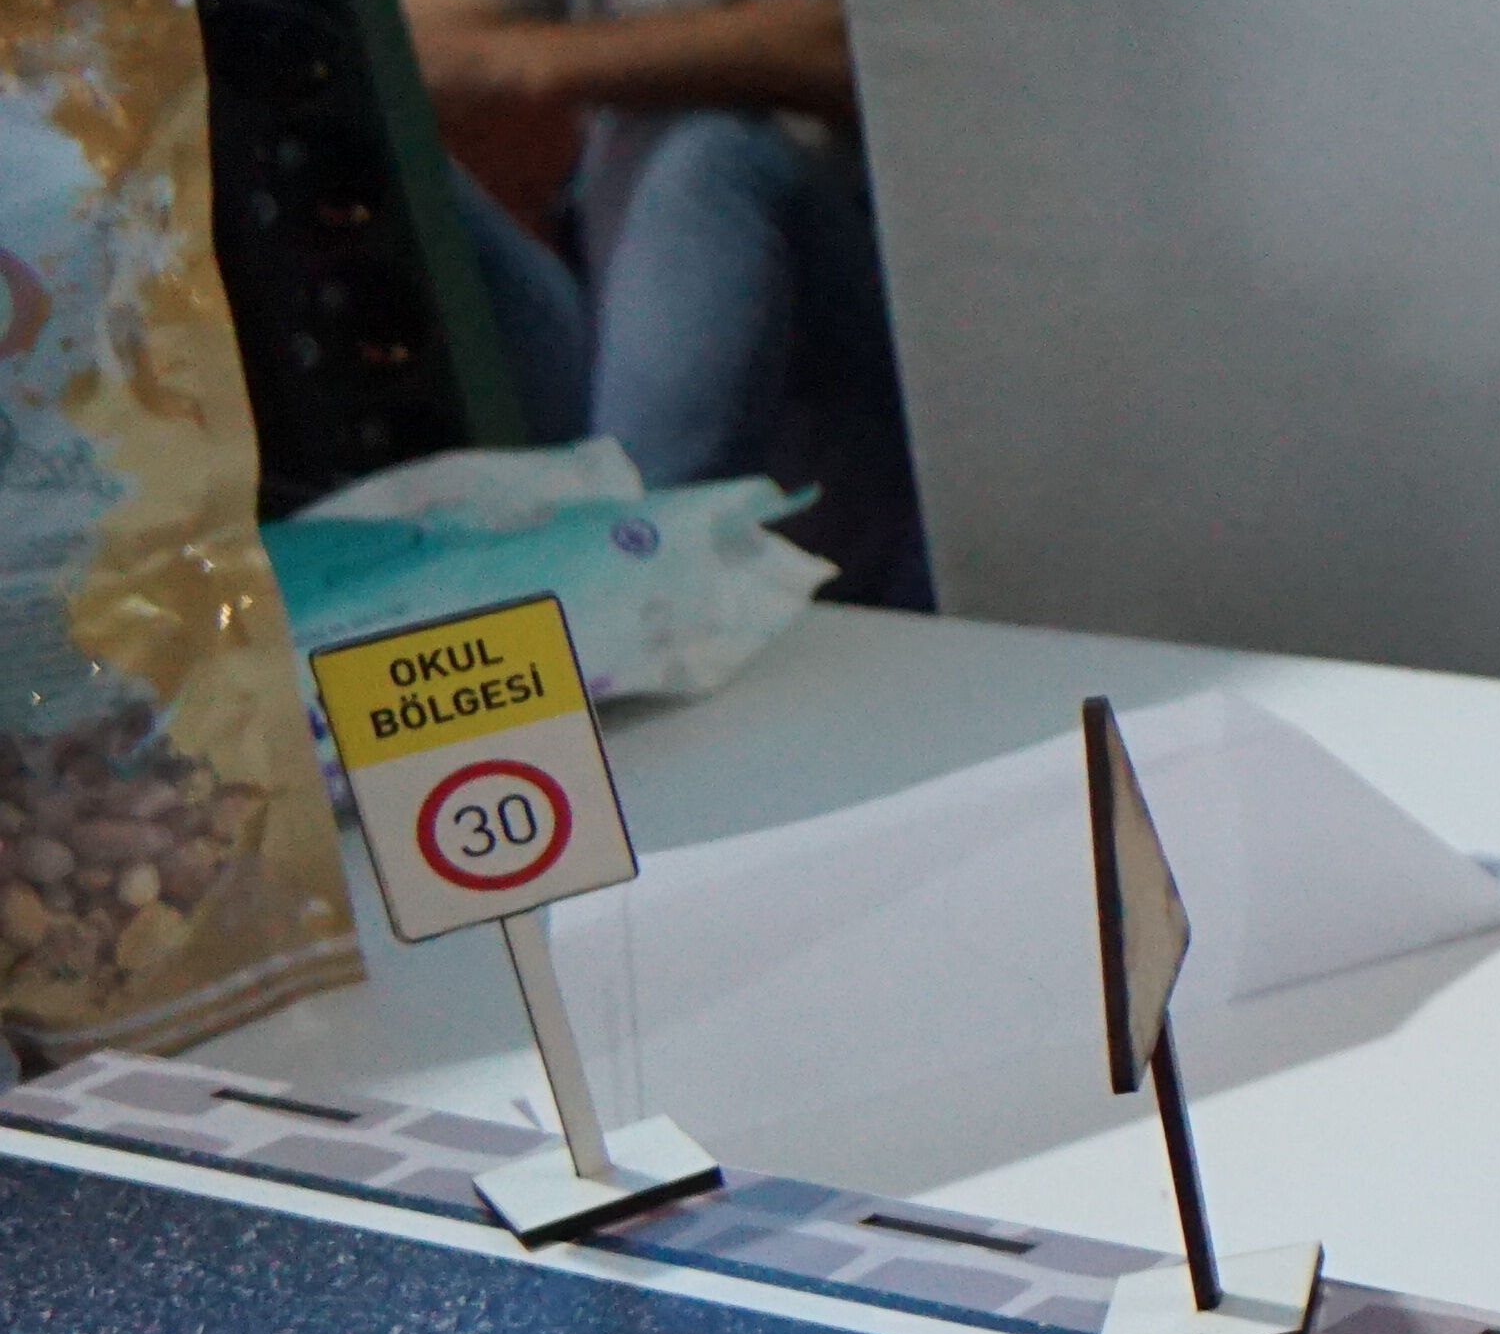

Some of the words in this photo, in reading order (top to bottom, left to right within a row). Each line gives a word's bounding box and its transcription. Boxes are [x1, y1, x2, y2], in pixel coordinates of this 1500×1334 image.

[389, 638, 504, 687] OKUL
[370, 662, 544, 739] BÖLGESİ
[454, 794, 537, 857] 30
